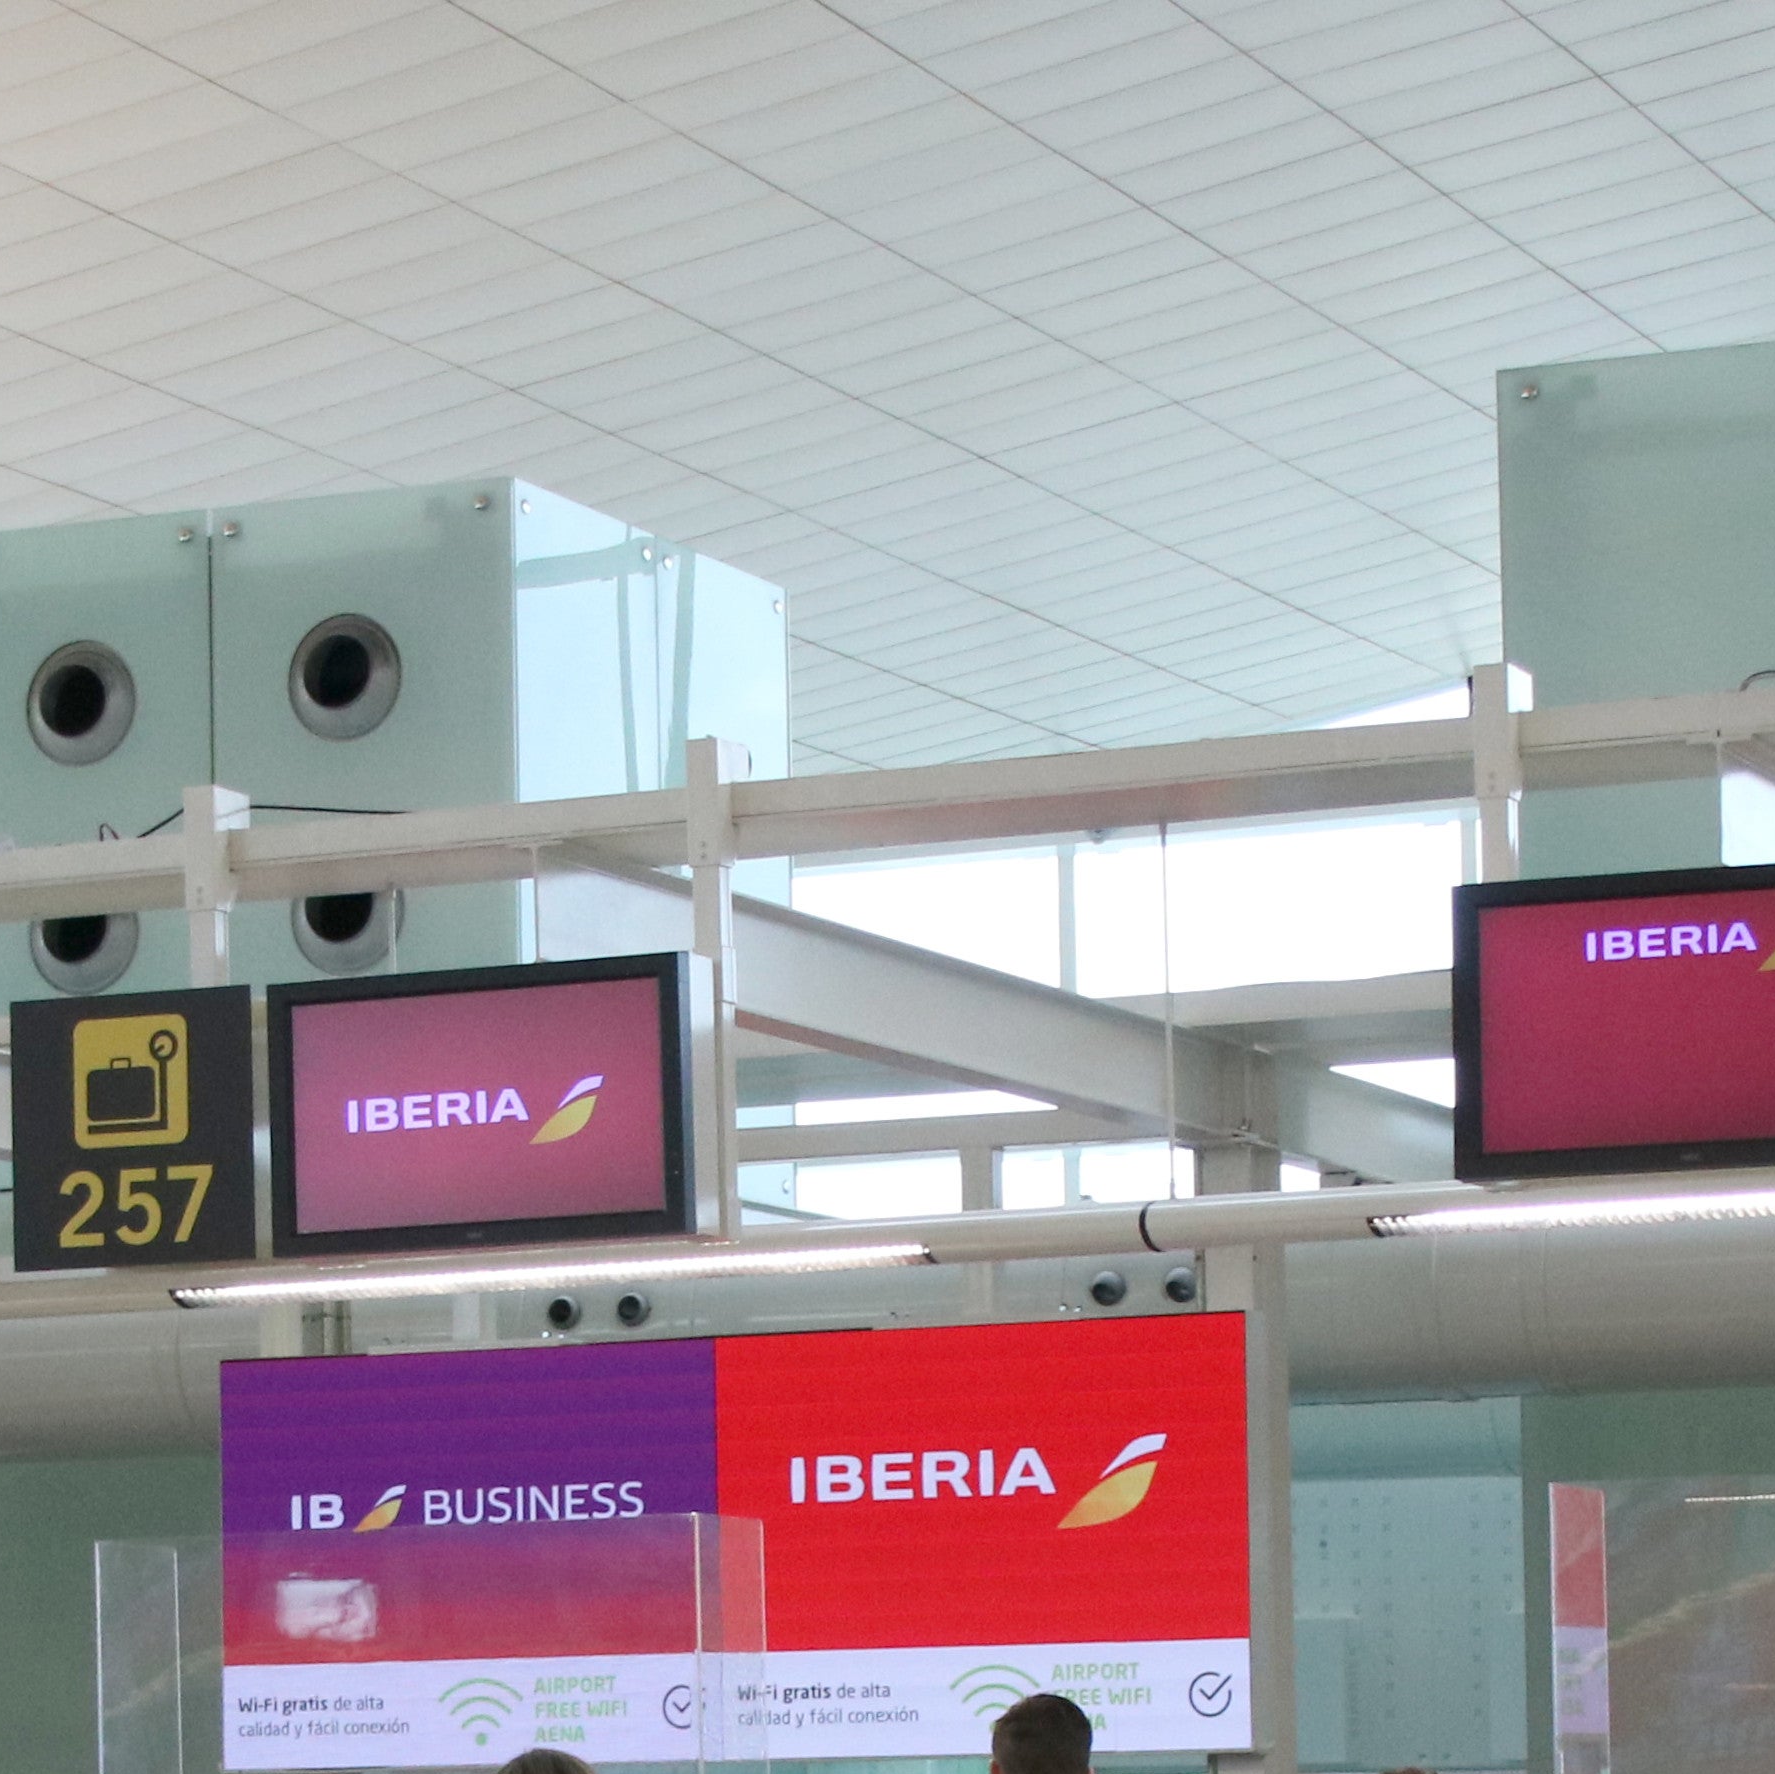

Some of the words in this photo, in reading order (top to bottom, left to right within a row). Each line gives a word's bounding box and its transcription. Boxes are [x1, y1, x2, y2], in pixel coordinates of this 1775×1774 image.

[1584, 922, 1757, 963] IBERIA
[347, 1088, 529, 1134] IBERIA
[59, 1164, 214, 1248] 257
[790, 1447, 1056, 1504] IBERIA
[291, 1494, 345, 1531] IB
[424, 1482, 644, 1527] BUSINESS
[1051, 1662, 1139, 1681] AIRPORT
[533, 1676, 616, 1694] AIRPORT
[782, 1682, 831, 1702] gratis
[836, 1684, 857, 1699] de
[861, 1682, 891, 1699] alta
[238, 1697, 277, 1712] Wi-Fi
[281, 1696, 328, 1716] gratis
[333, 1696, 352, 1711] de
[356, 1696, 384, 1711] alta
[1108, 1687, 1151, 1705] WIFI
[535, 1701, 582, 1718] FREE
[587, 1700, 627, 1717] WIFI
[794, 1712, 805, 1728] y
[810, 1705, 842, 1724] fácil
[848, 1706, 919, 1723] conexión
[238, 1720, 290, 1738] calidad
[293, 1724, 303, 1739] y
[307, 1718, 340, 1736] fácil
[344, 1719, 410, 1735] conexión
[534, 1726, 585, 1743] AENA
